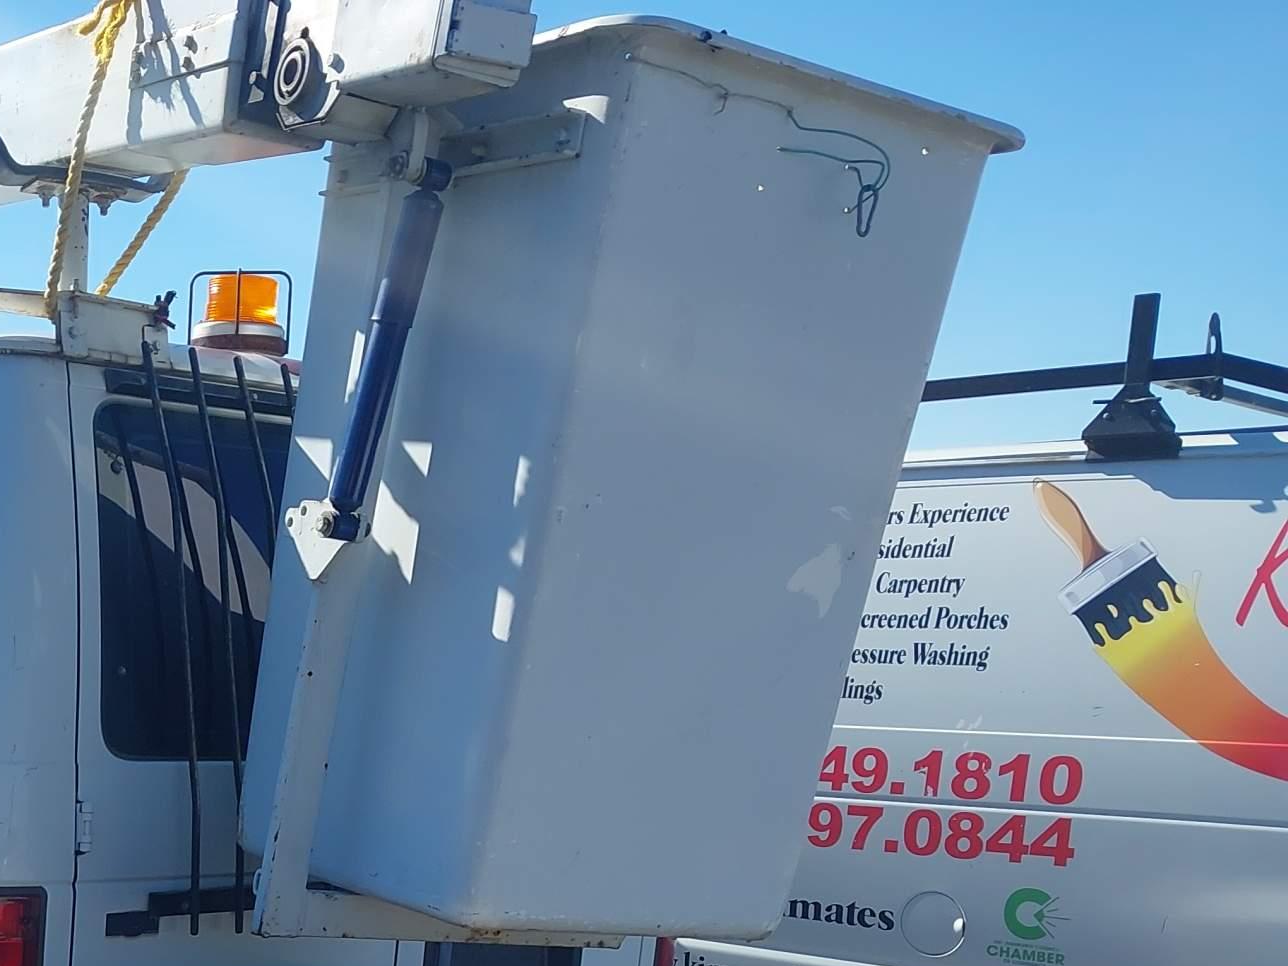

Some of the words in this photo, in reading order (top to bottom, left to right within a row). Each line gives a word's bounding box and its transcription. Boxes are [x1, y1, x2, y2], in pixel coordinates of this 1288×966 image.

[907, 502, 1010, 528] Experience
[876, 571, 966, 598] Carpentry
[934, 606, 1010, 630] Porches
[851, 648, 907, 665] essure
[912, 642, 991, 672] Washing
[841, 676, 884, 705] lings
[818, 745, 1083, 806] 49.1810
[807, 802, 1076, 867] 97.0844
[783, 898, 896, 931] mates
[986, 944, 1065, 966] CHAMBER
